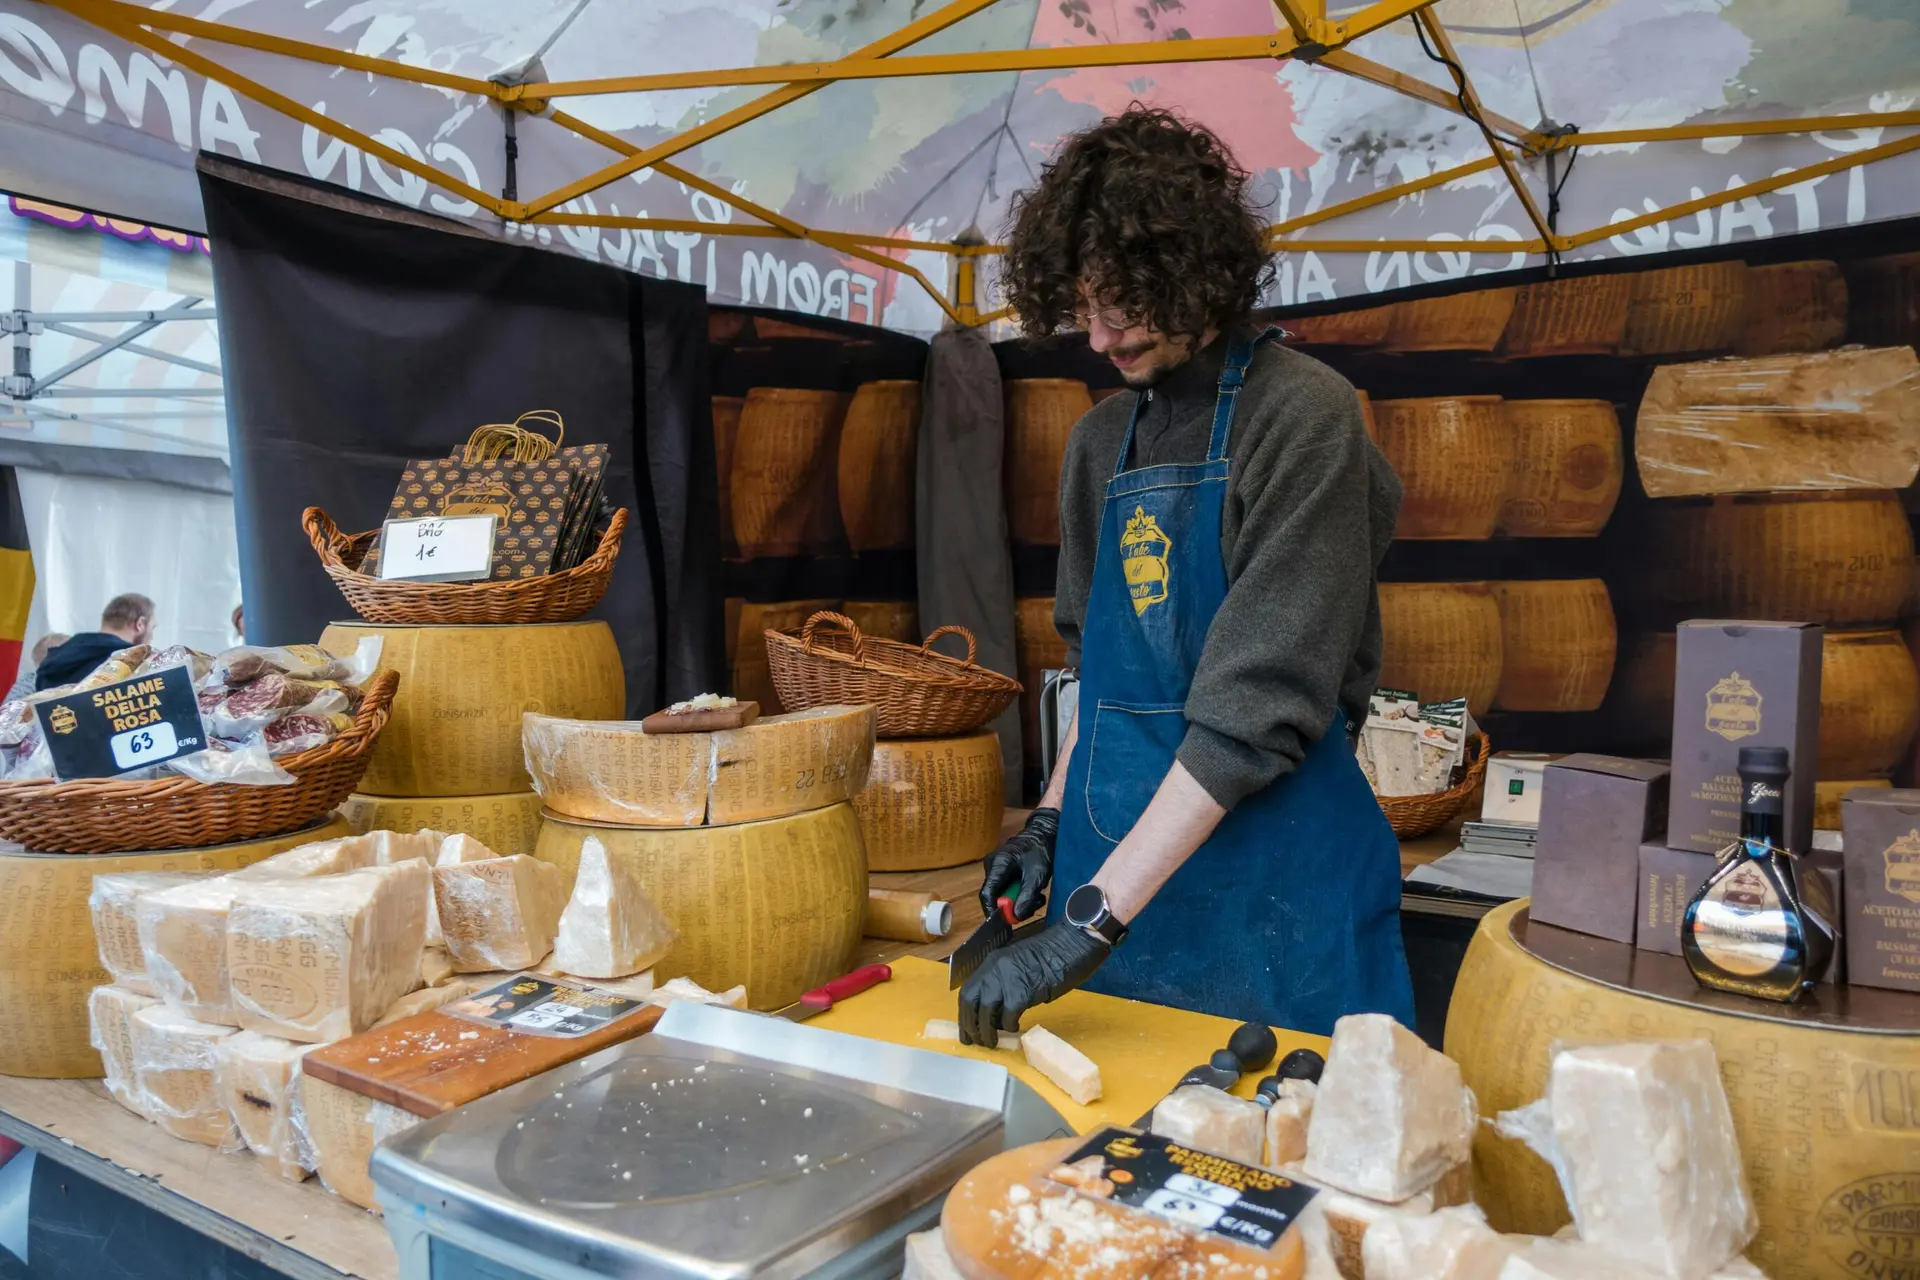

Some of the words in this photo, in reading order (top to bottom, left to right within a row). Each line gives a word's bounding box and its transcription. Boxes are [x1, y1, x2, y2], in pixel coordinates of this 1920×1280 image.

[92, 677, 166, 707] SALAME
[104, 694, 162, 720] DELLA
[113, 709, 162, 732] ROSA
[130, 732, 154, 753] 63
[1702, 783, 1743, 792] BALSAM
